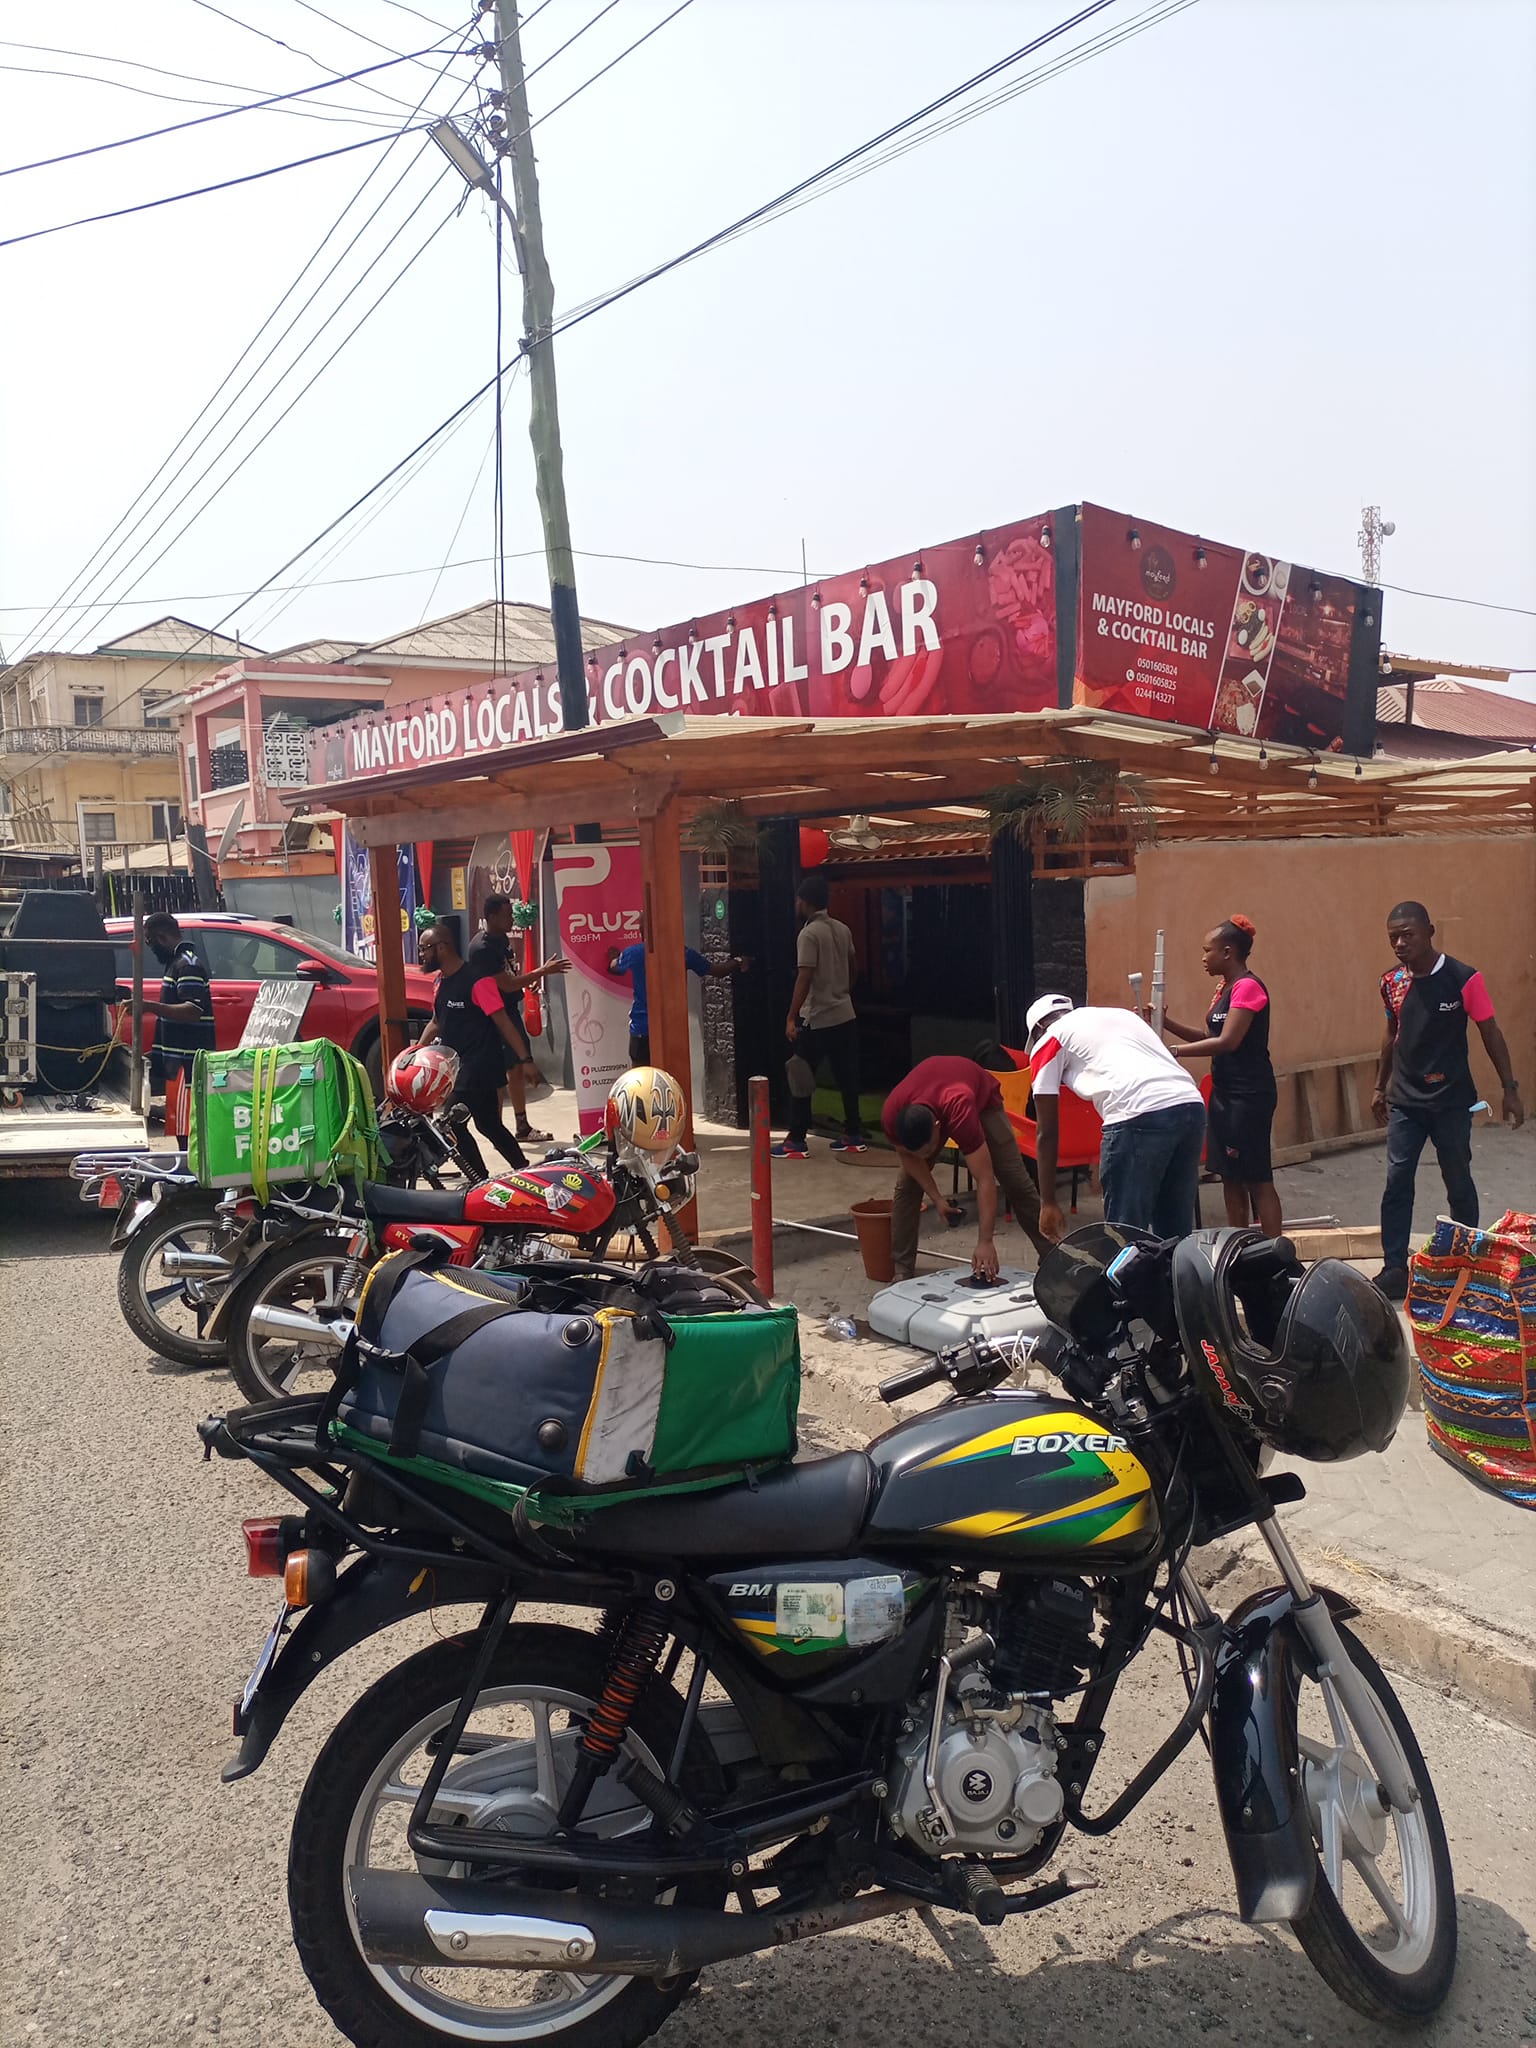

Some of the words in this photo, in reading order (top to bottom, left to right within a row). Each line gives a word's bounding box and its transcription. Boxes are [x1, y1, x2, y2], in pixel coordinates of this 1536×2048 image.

[1092, 593, 1163, 625] MAYFORD
[1165, 611, 1215, 639] LOCALS
[1097, 617, 1109, 636] &
[1112, 621, 1178, 653] COCKTAIL
[1181, 637, 1208, 659] BAR
[353, 708, 457, 771] MAYFORD
[463, 682, 564, 750] LOCALS
[603, 615, 808, 720] COCKTAIL
[820, 579, 941, 675] BAR
[1137, 658, 1178, 676] 0501605824
[1136, 672, 1177, 691] 0501605825
[1135, 687, 1176, 705] 0244143271
[568, 910, 643, 933] PLUZ
[235, 1128, 300, 1159] Fod
[1200, 1339, 1241, 1406] JAPAN
[1010, 1434, 1130, 1456] BOXER
[728, 1583, 773, 1597] BM
